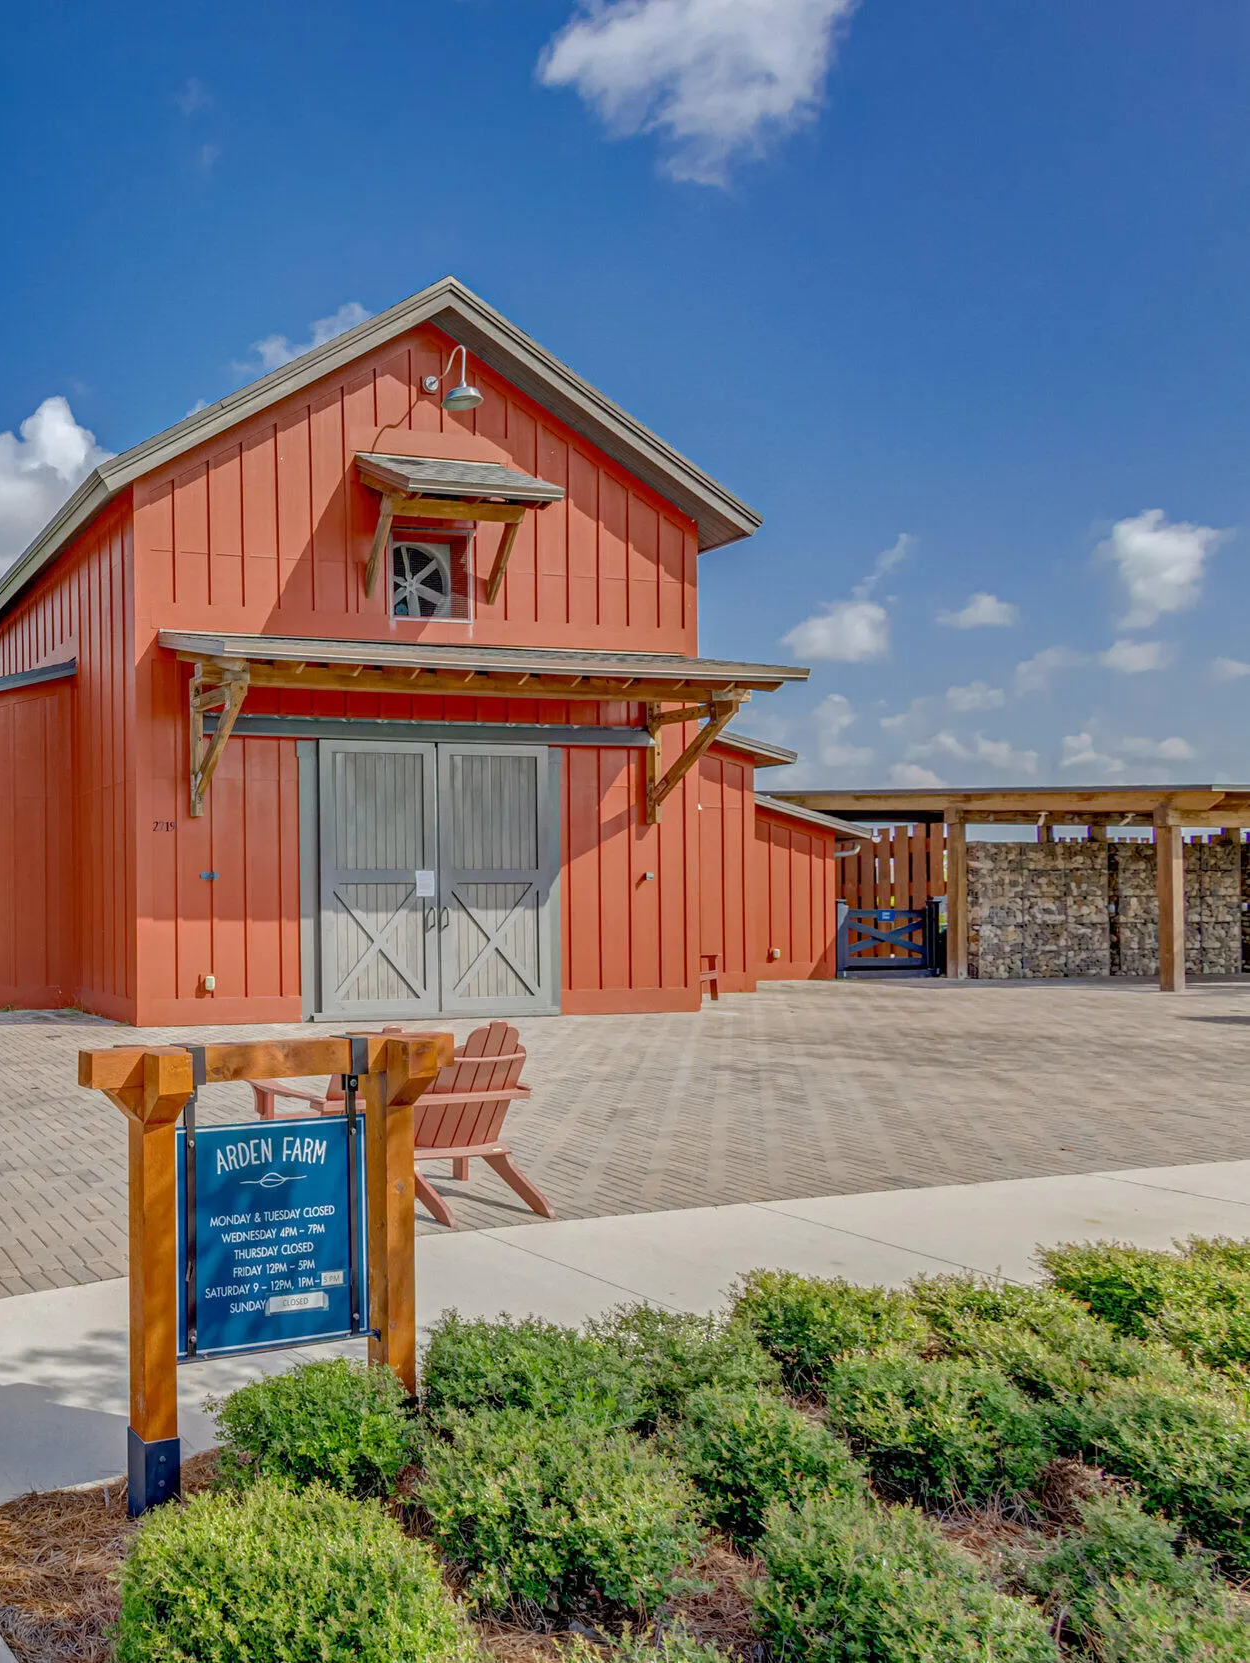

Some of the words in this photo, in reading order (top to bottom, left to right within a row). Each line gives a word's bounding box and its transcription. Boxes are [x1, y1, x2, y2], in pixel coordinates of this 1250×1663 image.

[217, 1138, 272, 1174] ARDEN
[283, 1137, 327, 1164] FARM
[210, 1213, 251, 1227] MONDAY
[254, 1212, 261, 1222] &
[264, 1208, 301, 1222] TUESDAY
[303, 1205, 335, 1218] CLOSED
[221, 1228, 277, 1243] WEDNESDAY
[280, 1227, 298, 1237] 4PM
[308, 1224, 325, 1235] 7PM
[234, 1246, 278, 1260] THURSDAY
[281, 1242, 314, 1255] CLOSED
[233, 1265, 263, 1278] FRIDAY
[266, 1263, 287, 1274] 12PM
[298, 1259, 315, 1270] 5PM
[205, 1284, 250, 1299] SATURDAY
[253, 1283, 259, 1293] 9
[271, 1280, 294, 1291] 12PM,
[298, 1277, 314, 1288] 1PM
[230, 1300, 266, 1313] SUNDAY
[282, 1297, 309, 1307] CLOSED
